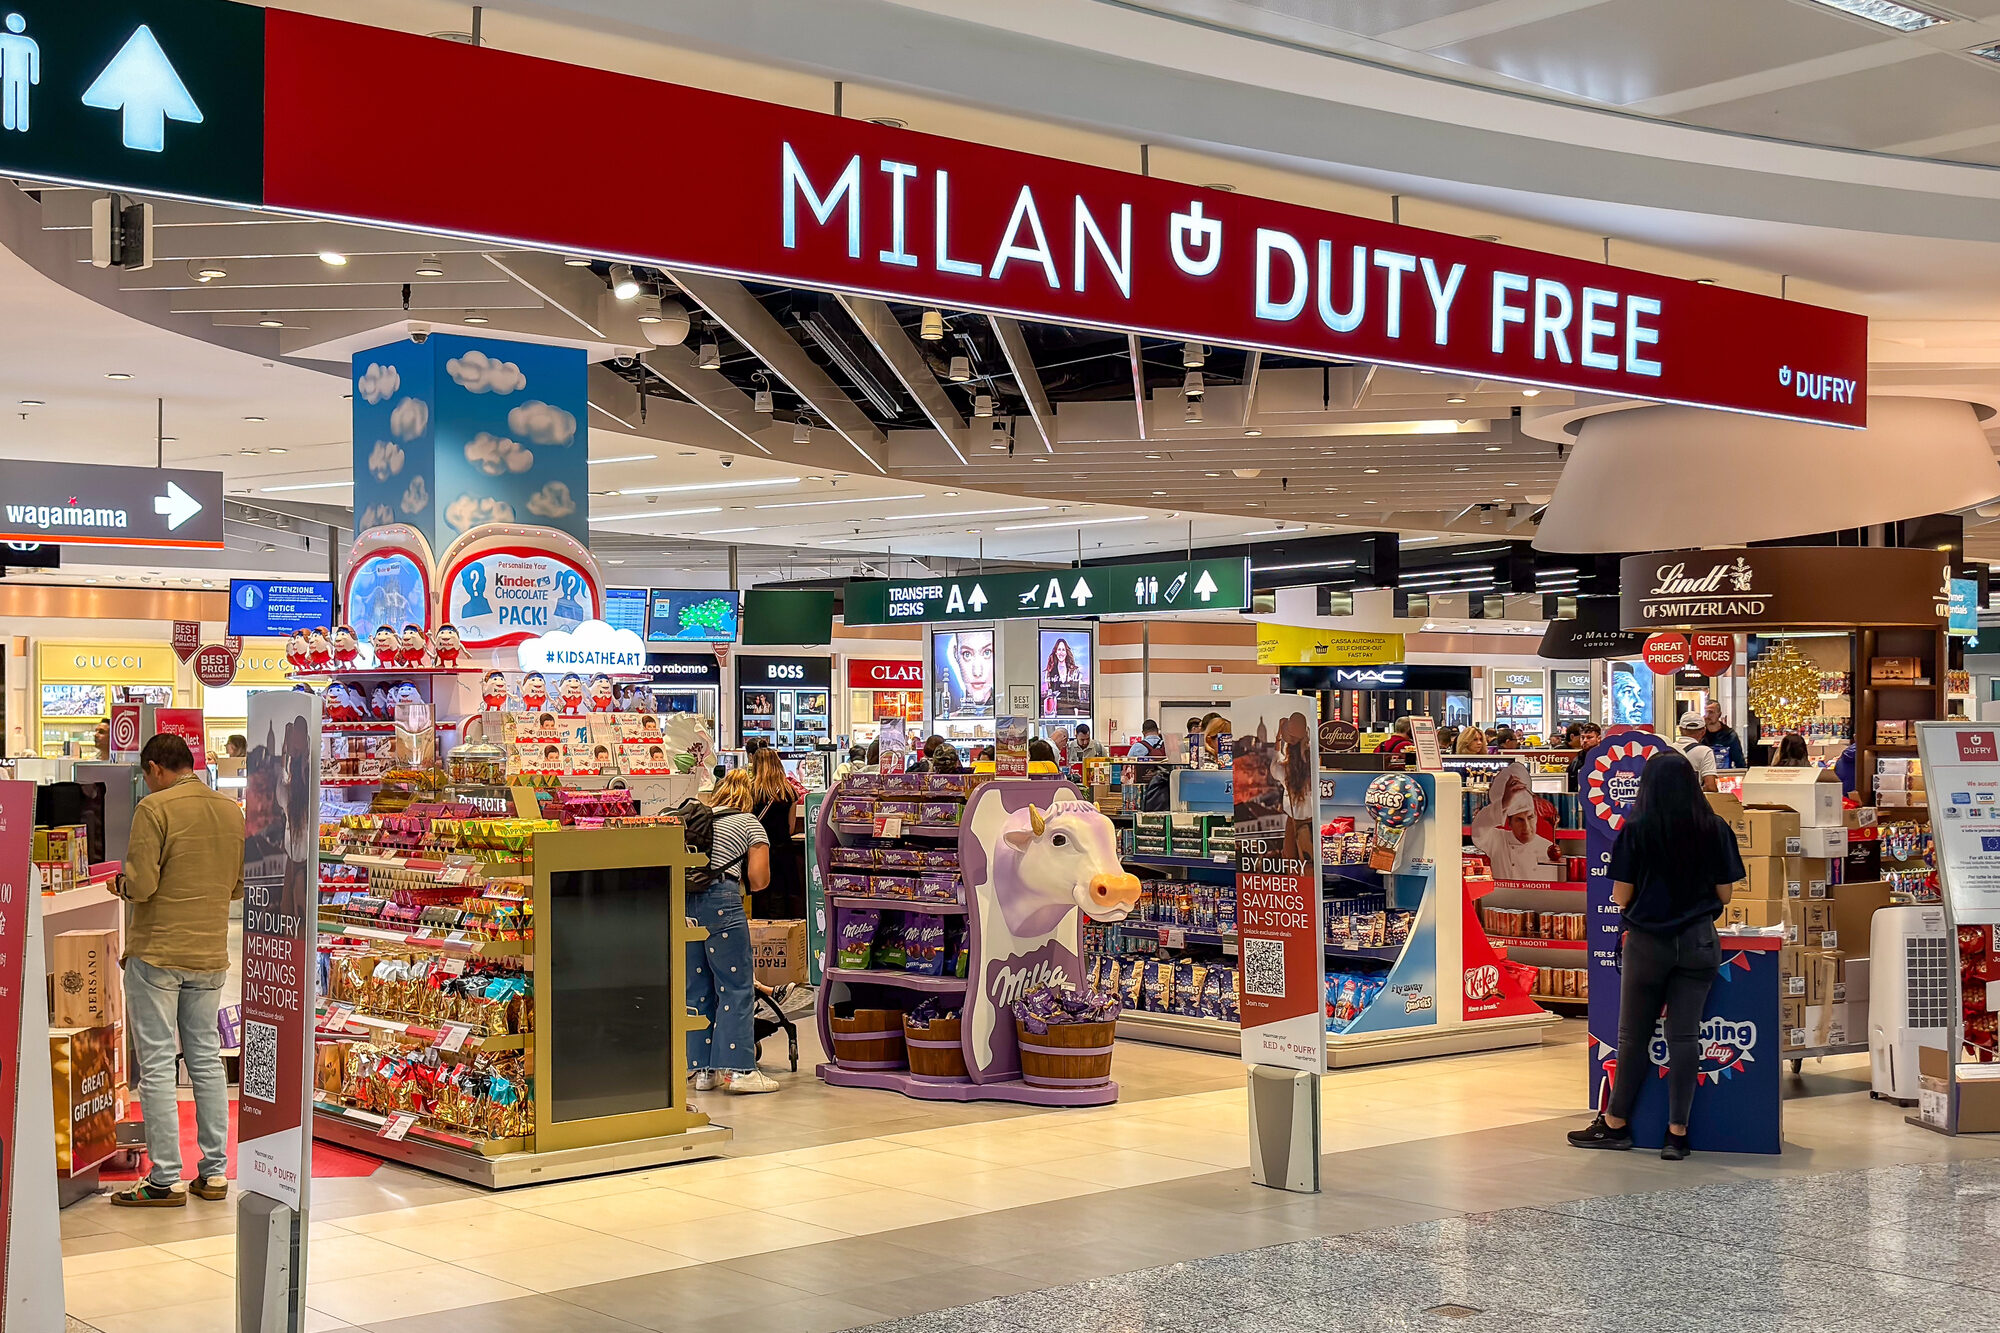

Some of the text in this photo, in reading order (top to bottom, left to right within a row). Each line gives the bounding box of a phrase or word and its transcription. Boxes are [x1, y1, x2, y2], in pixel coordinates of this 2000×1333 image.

[783, 141, 1131, 299] MILAN
[1255, 227, 1662, 377] DUTY FREE
[1796, 371, 1857, 405] DUFRY
[6, 505, 128, 529] wagamama
[498, 561, 532, 570] Personalize
[495, 572, 535, 587] Kinder
[1650, 562, 1730, 595] Lindt
[268, 585, 314, 594] ATTENZIONE
[495, 586, 548, 601] CHOCOLATE
[888, 585, 943, 601] TRANSFER
[1043, 578, 1065, 608] A
[945, 584, 965, 614] A
[268, 604, 295, 612] NOTICE
[499, 604, 548, 626] PACK!
[888, 602, 924, 617] DESKS
[1643, 600, 1765, 619] OF SWITZERLAND
[175, 625, 196, 634] BEST
[1585, 631, 1635, 640] MALONE
[175, 633, 197, 643] PRICE
[1697, 636, 1728, 647] GREAT
[1649, 642, 1683, 652] GREAT
[75, 656, 142, 669] GUCCI
[201, 655, 230, 665] BEST
[546, 650, 640, 667] #KIDSATHEART
[1648, 654, 1684, 664] PRICES
[1696, 650, 1730, 662] PRICES
[201, 664, 230, 674] PRICE
[236, 658, 290, 671] GUCC
[662, 663, 708, 674] rabanne
[768, 665, 804, 679] BOSS
[871, 665, 925, 680] CLARI
[161, 721, 184, 733] Reserve
[1319, 725, 1356, 745] Caffarel
[1524, 755, 1569, 763] eat Offers
[1610, 777, 1640, 788] chew
[1611, 787, 1636, 798] gum
[1241, 839, 1268, 854] RED
[1241, 857, 1308, 877] BY DUFRY
[878, 879, 894, 890] Milka
[922, 880, 940, 892] Milka
[1242, 876, 1298, 893] MEMBER
[248, 886, 270, 907] RED
[1242, 892, 1304, 911] SAVINGS
[1597, 905, 1621, 914] E MET
[248, 910, 301, 940] BY DUFRY
[1243, 909, 1309, 929] IN-STORE
[842, 922, 875, 938] Milka
[921, 925, 944, 942] Milka
[247, 935, 292, 961] MEMBER
[754, 958, 787, 967] FRAGI
[246, 958, 296, 986] SAVINGS
[87, 949, 97, 1013] BERSANO
[992, 959, 1069, 1008] Milka
[1403, 983, 1424, 993] away
[1470, 966, 1496, 997] KitKat
[245, 982, 299, 1011] IN-STORE
[1263, 1040, 1278, 1050] RED
[1293, 1046, 1317, 1055] DUFRY
[1706, 1044, 1731, 1062] day
[81, 1071, 105, 1094] GREAT
[74, 1091, 113, 1122] GIFT IDEAS
[243, 1103, 262, 1116] Join now
[254, 1160, 267, 1173] RED
[278, 1168, 297, 1184] DUFRY
